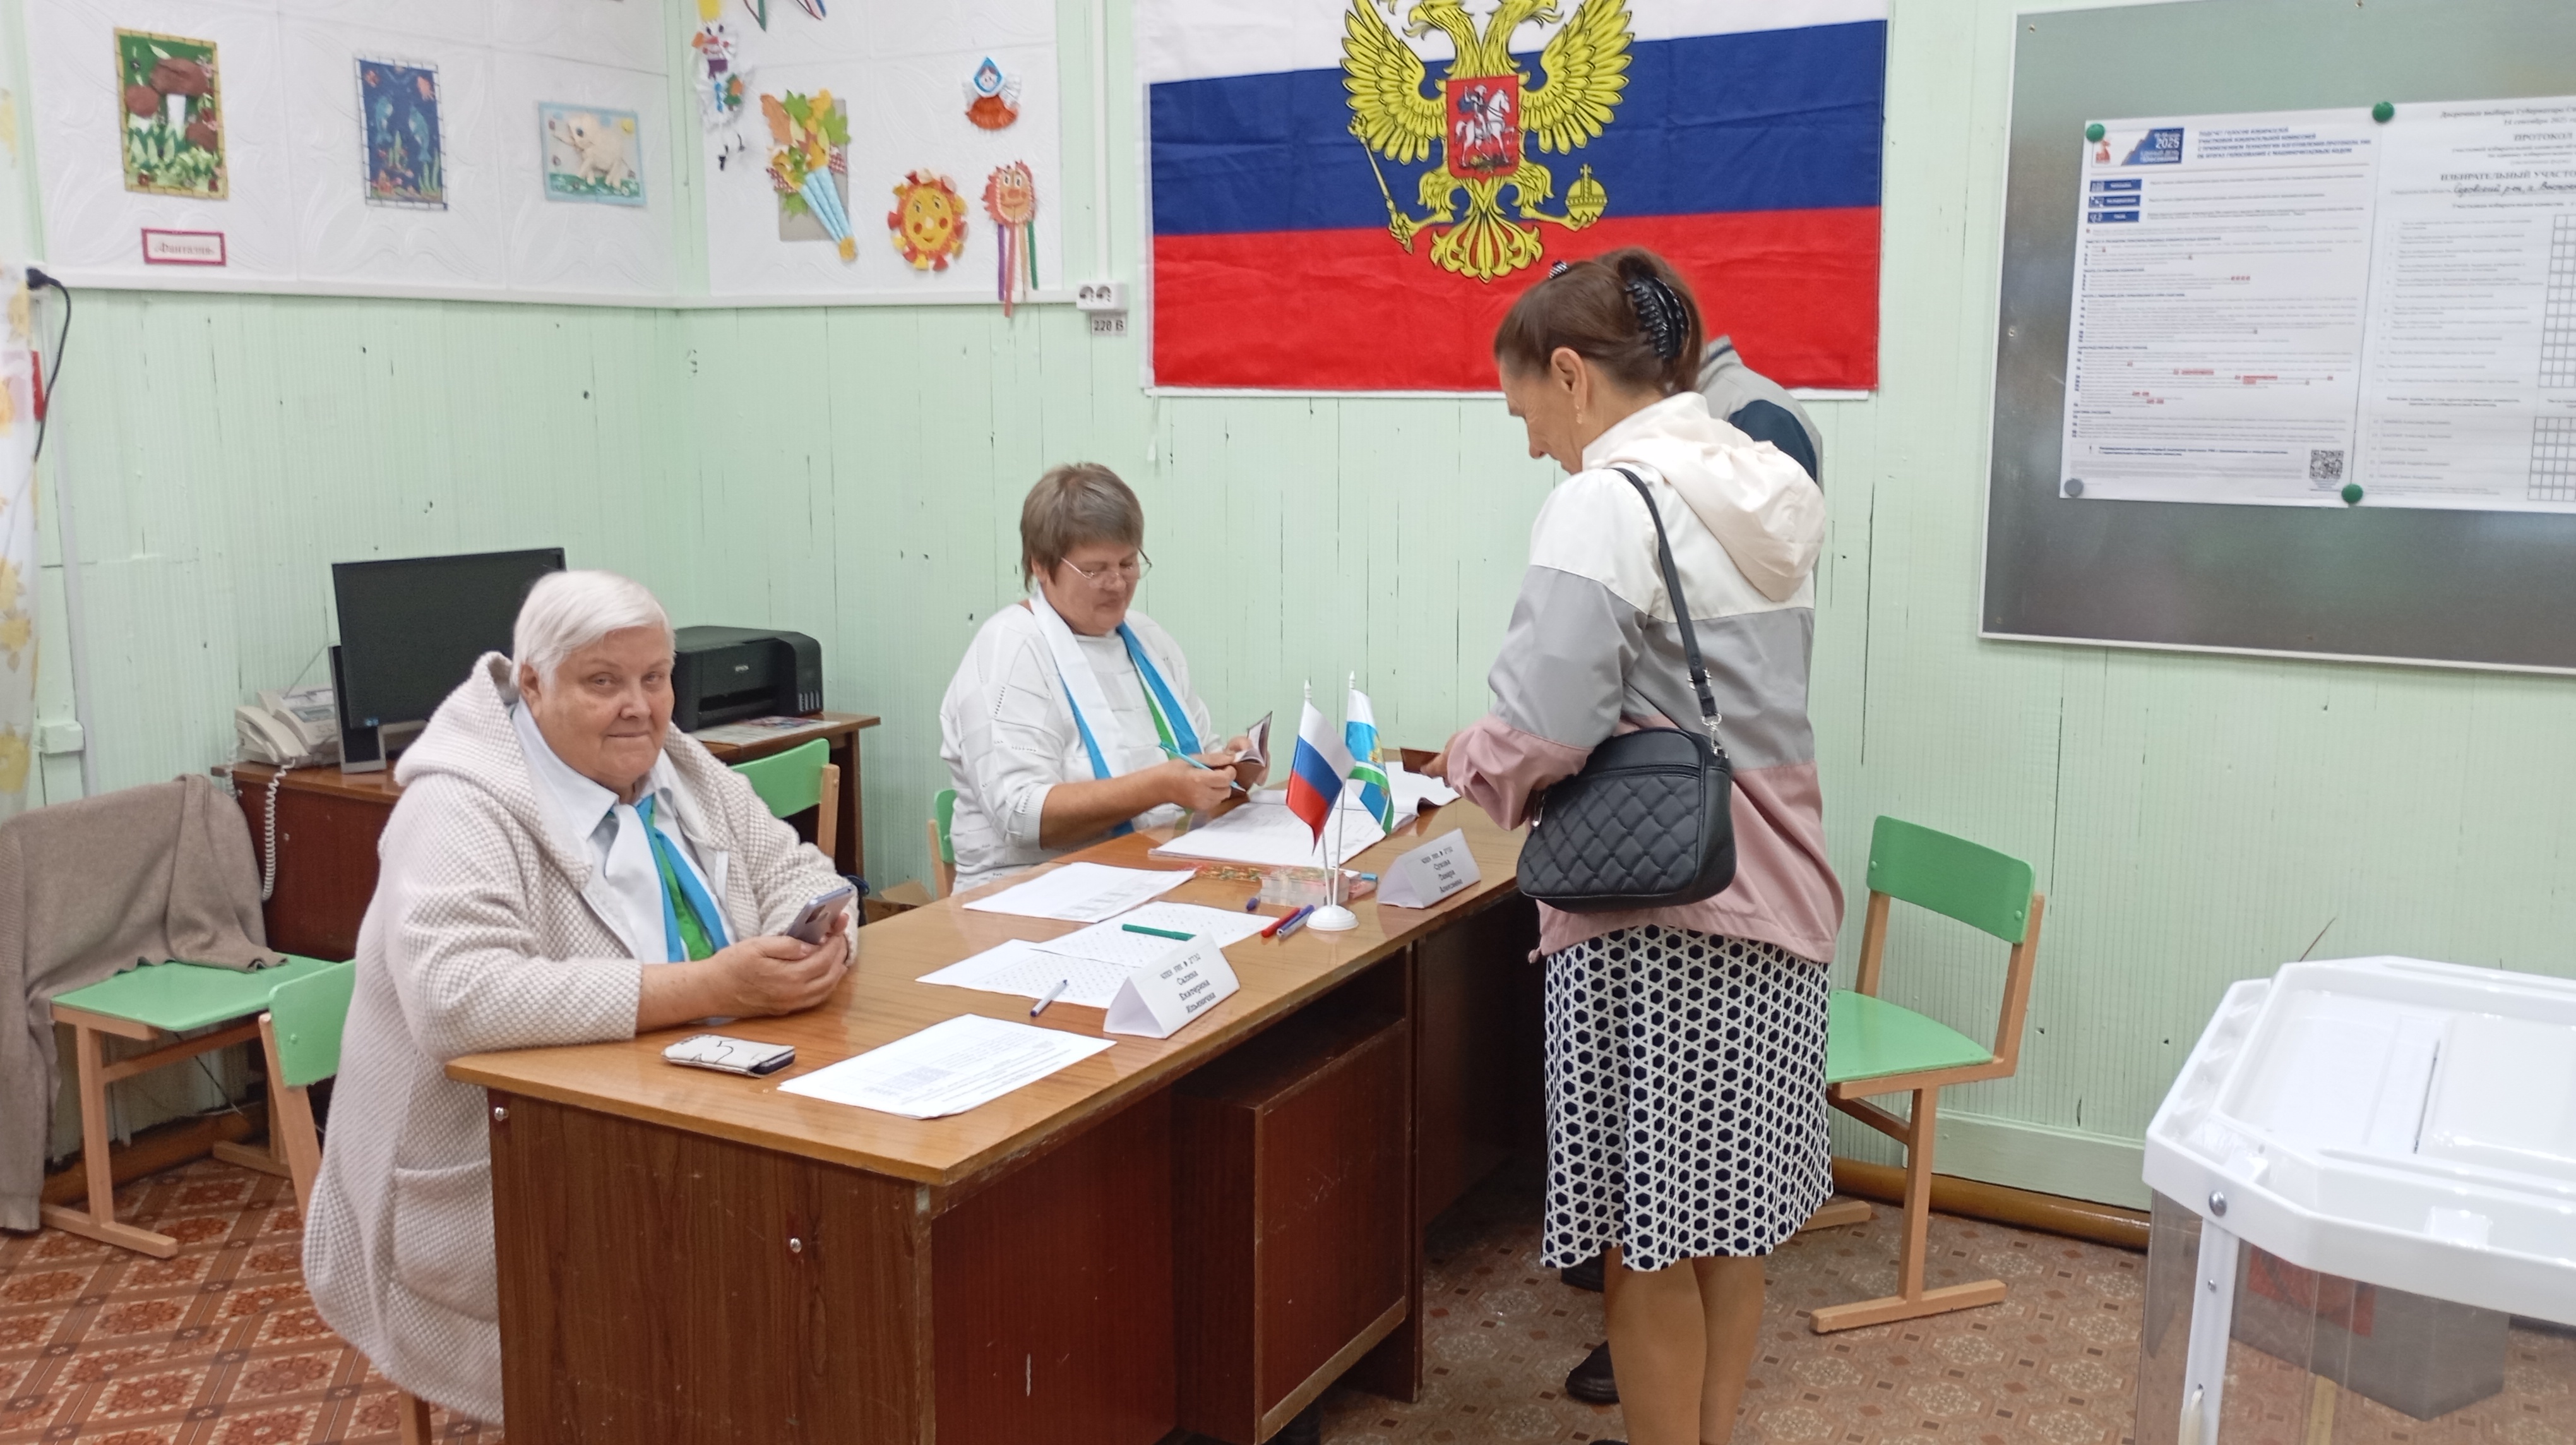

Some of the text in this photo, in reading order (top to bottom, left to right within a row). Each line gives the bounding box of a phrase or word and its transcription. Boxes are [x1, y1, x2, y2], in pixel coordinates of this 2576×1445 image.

[2514, 132, 2573, 141] ПРОТОКОЛ
[2155, 138, 2180, 149] 2025
[1094, 319, 1112, 332] 220
